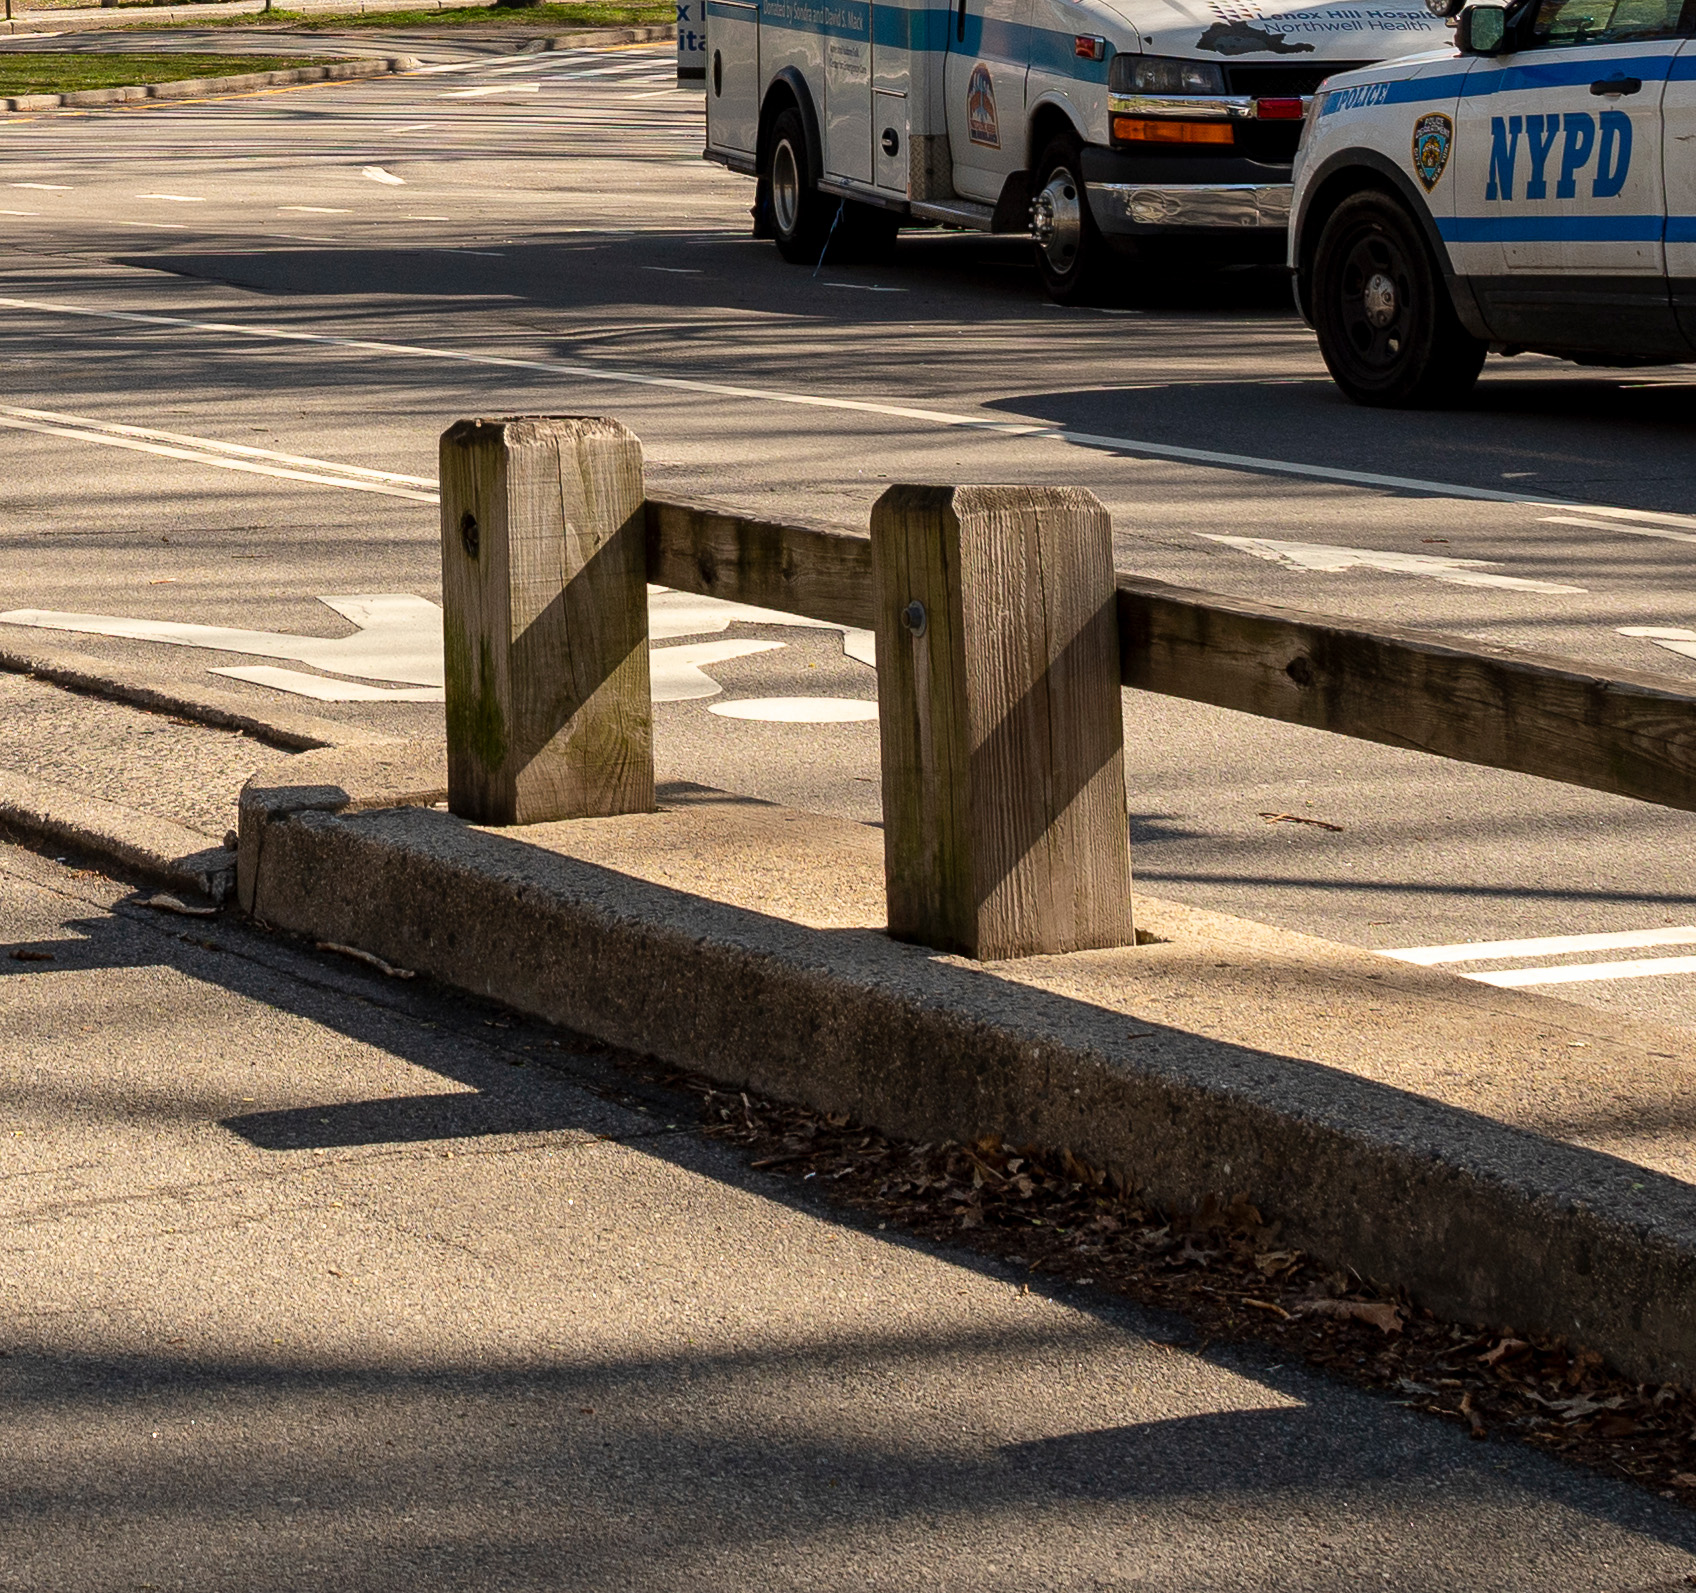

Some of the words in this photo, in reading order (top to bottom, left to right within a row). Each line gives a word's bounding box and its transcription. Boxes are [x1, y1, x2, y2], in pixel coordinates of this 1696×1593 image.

[825, 7, 841, 28] David
[1257, 10, 1323, 22] Lenox
[1327, 9, 1361, 20] Hill
[1366, 9, 1441, 20] Hospit
[1264, 19, 1364, 33] Northwell
[1369, 19, 1432, 32] Health
[1336, 82, 1391, 111] POLICE
[1485, 110, 1633, 201] NYPD
